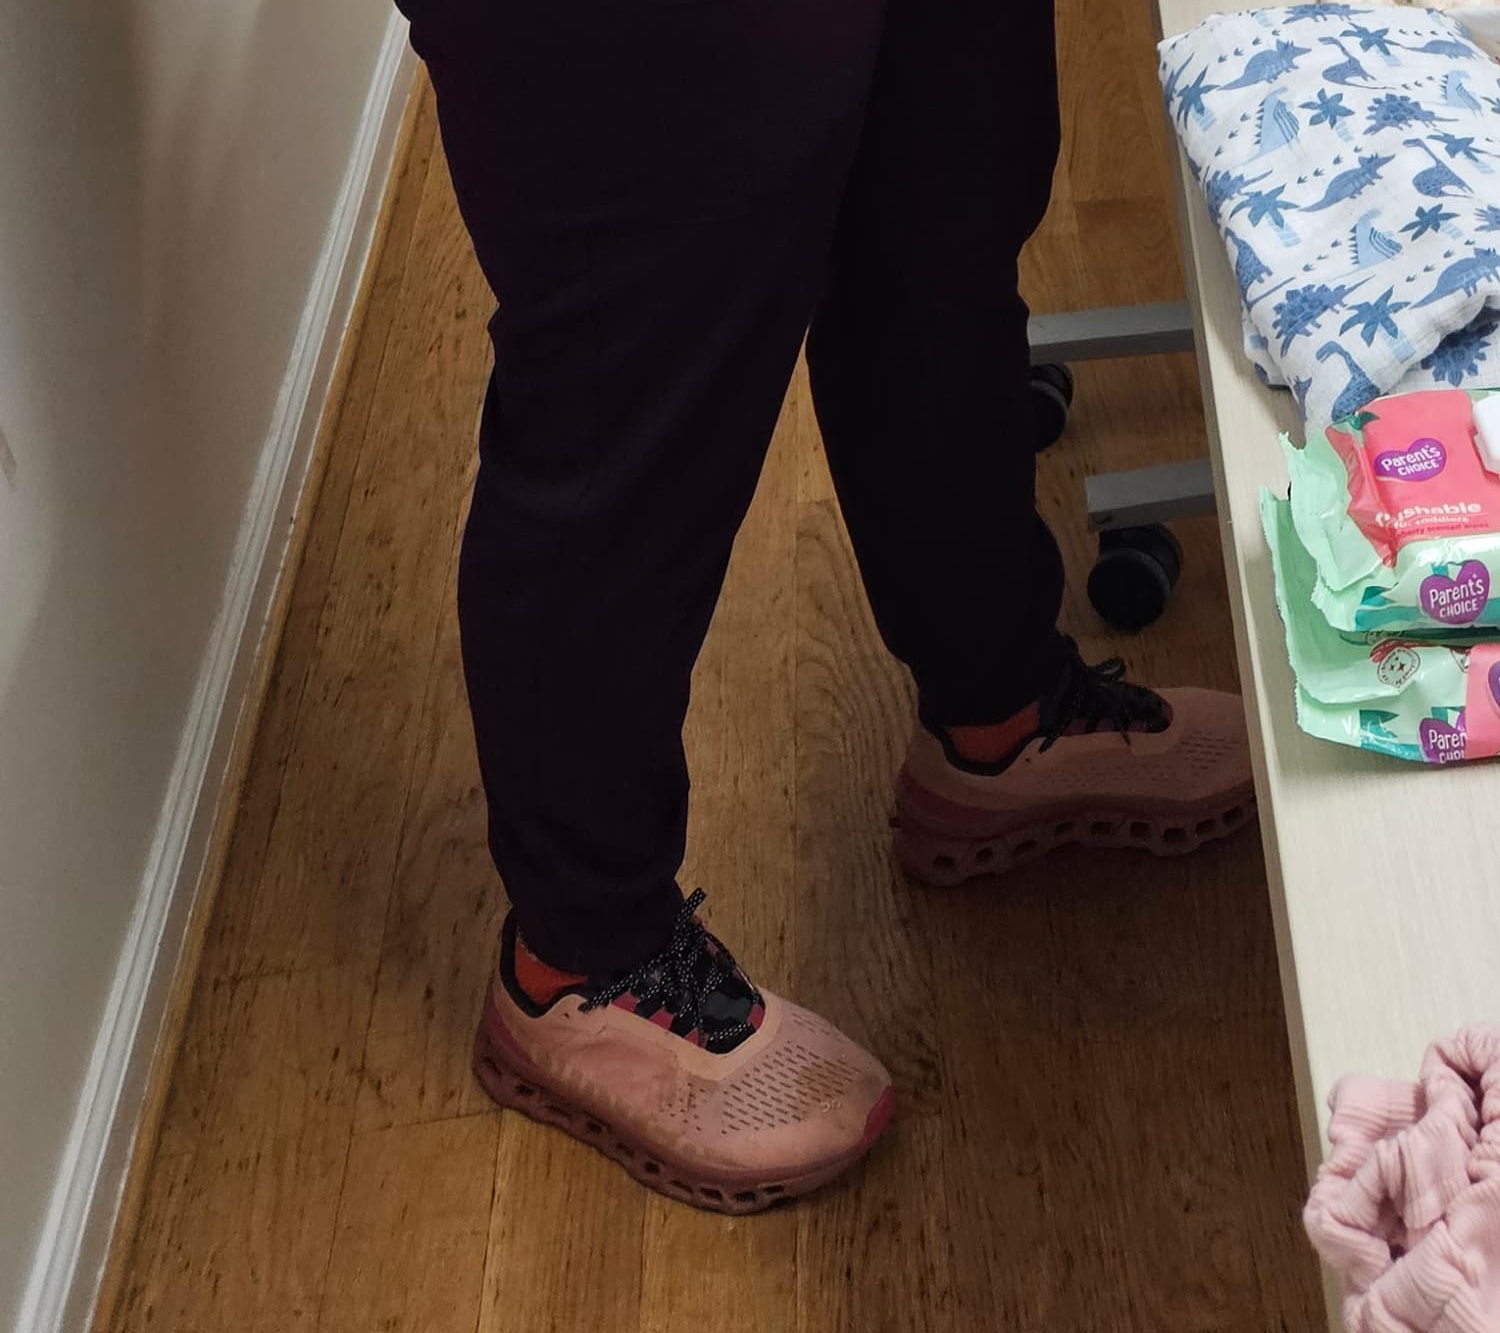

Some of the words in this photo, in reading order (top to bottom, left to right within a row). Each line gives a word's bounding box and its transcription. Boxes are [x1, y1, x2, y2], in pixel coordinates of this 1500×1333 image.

[1381, 445, 1441, 471] Parent's
[1397, 459, 1440, 476] CHOICE
[1429, 573, 1484, 609] Parent's
[1440, 598, 1478, 618] CHOICE
